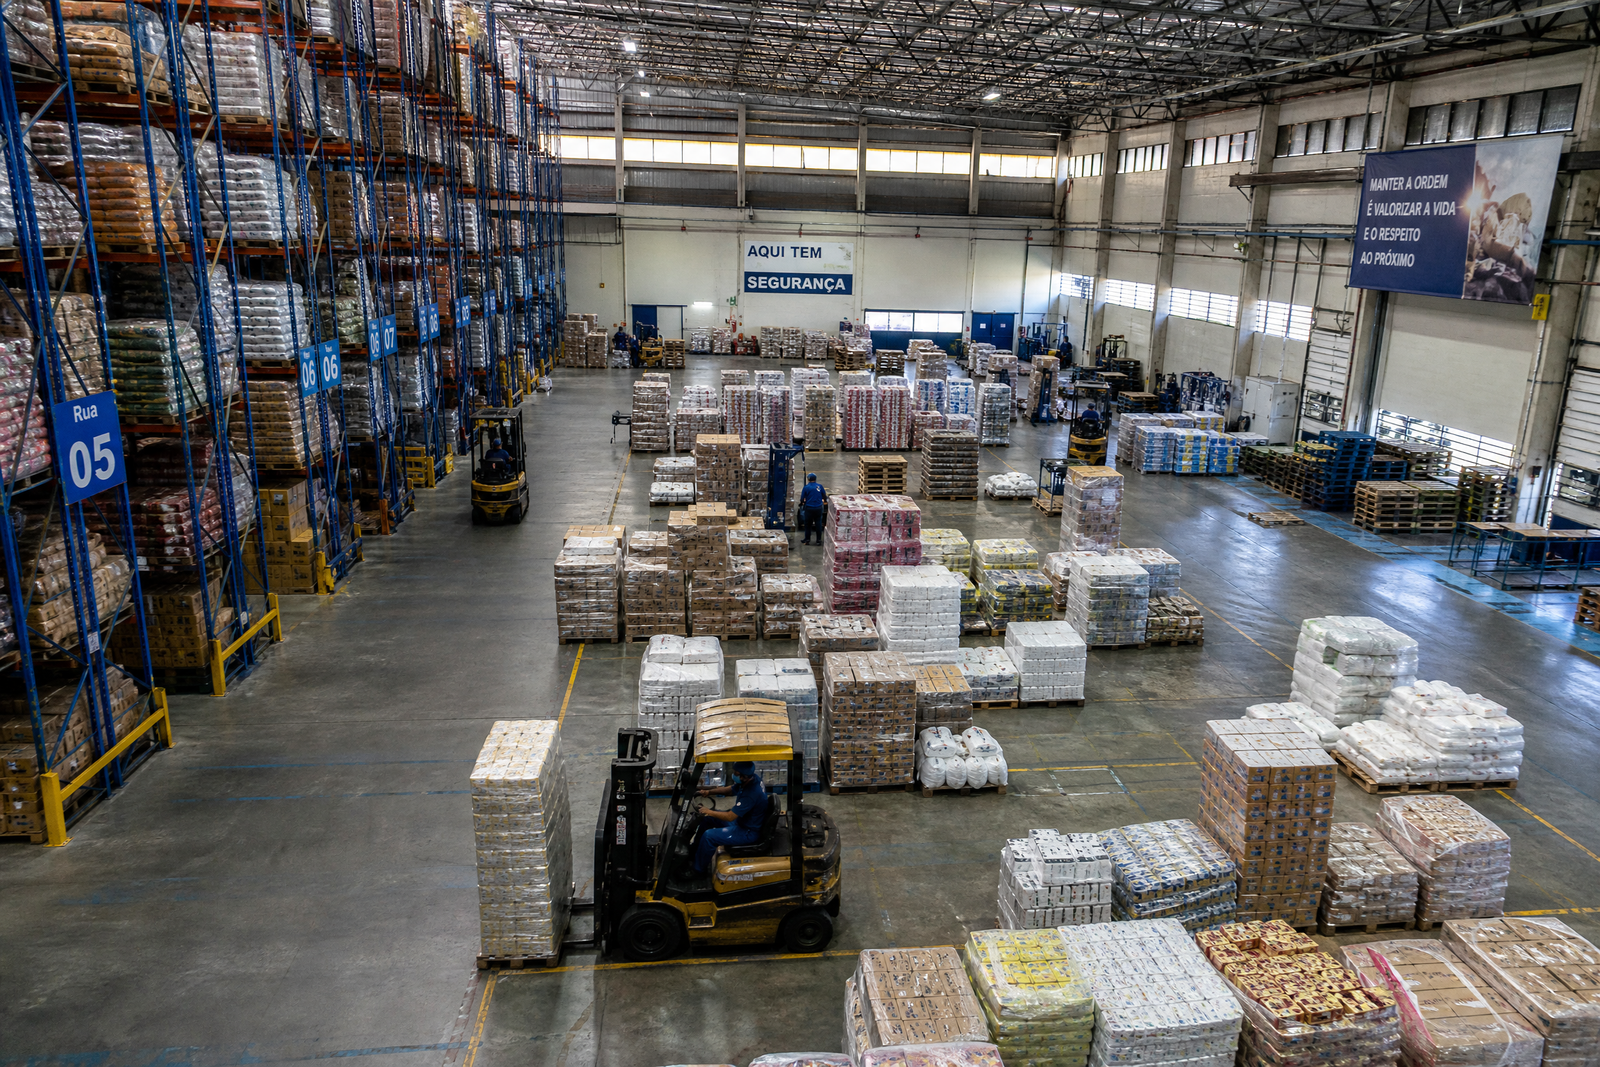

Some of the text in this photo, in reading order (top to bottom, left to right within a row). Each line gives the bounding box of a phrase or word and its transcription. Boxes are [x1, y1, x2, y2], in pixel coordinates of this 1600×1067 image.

[1369, 174, 1449, 191] MANTER A ORDEM
[1367, 199, 1456, 216] É VALORIZAR A VIDA
[1363, 227, 1421, 241] E O RESPEITO
[747, 245, 822, 259] AQUI TEM
[1360, 249, 1415, 267] AO PRÓXIMO
[747, 276, 846, 293] SEGURANÇA
[370, 332, 379, 354] 06
[384, 327, 394, 350] 07
[302, 360, 316, 388] 06
[323, 354, 338, 382] 06
[73, 404, 98, 423] Rua
[69, 432, 116, 488] 05
